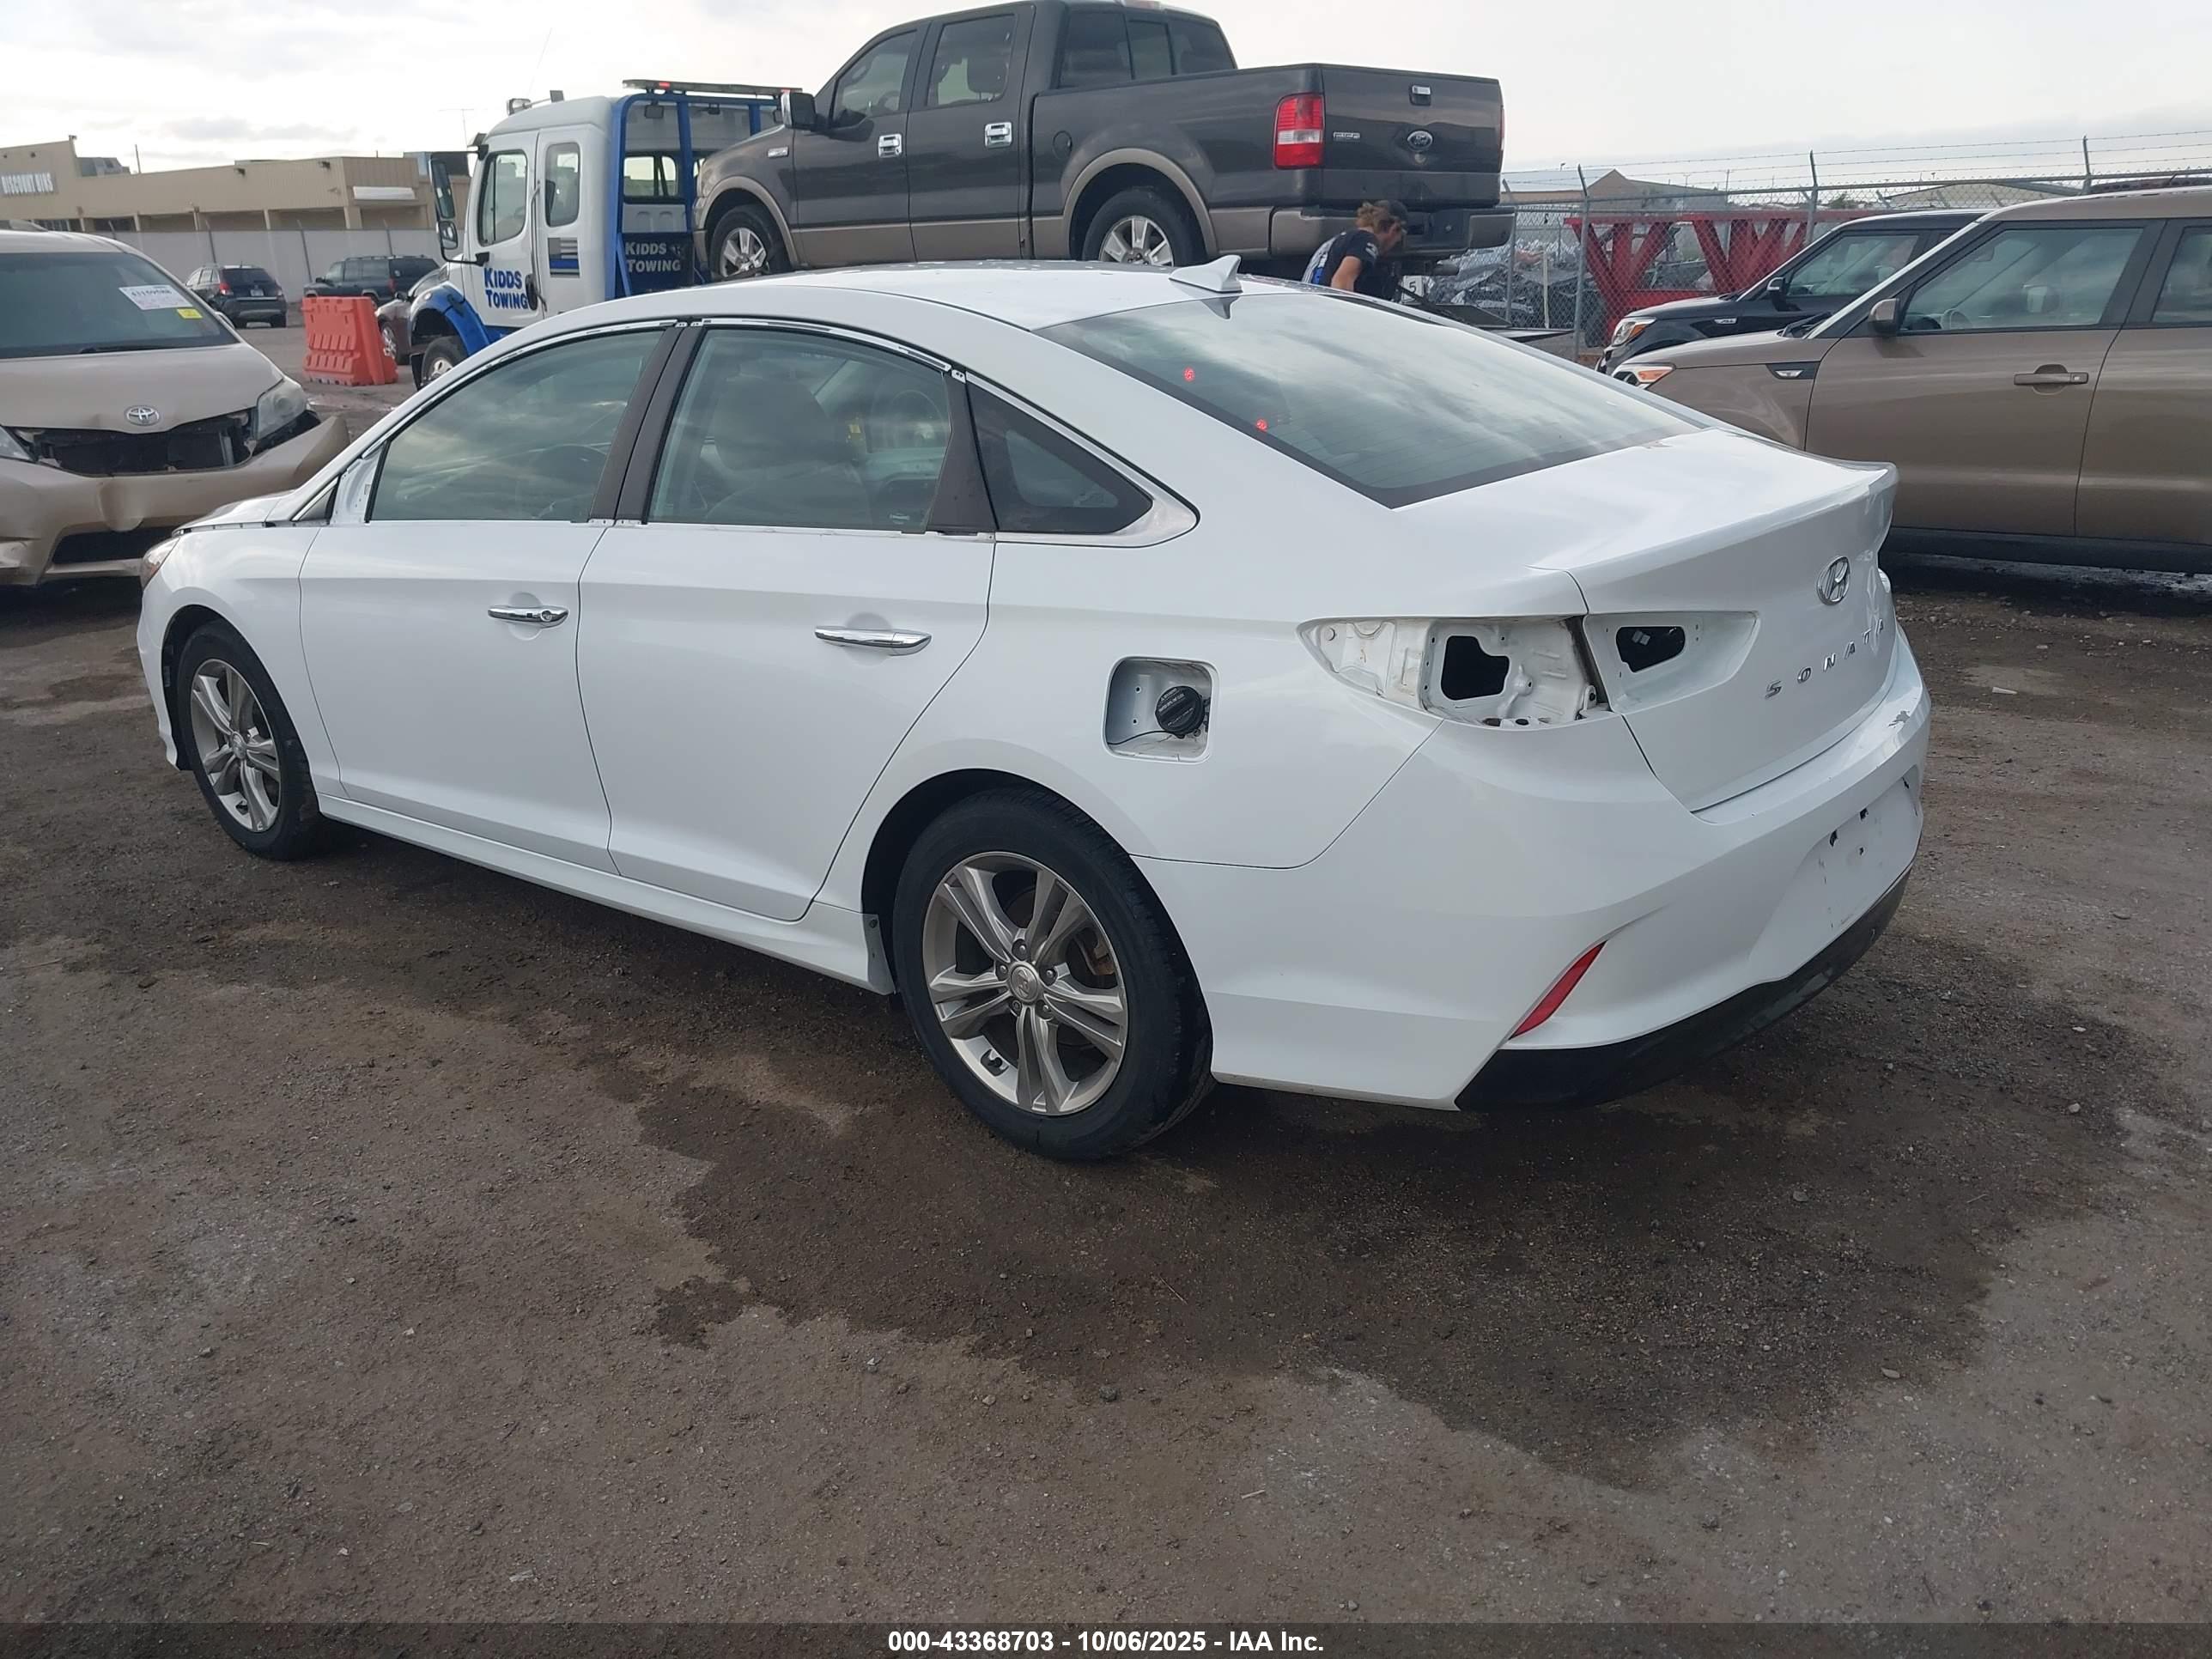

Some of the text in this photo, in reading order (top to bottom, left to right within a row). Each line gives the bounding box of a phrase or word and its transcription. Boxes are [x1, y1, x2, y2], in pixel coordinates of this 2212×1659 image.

[625, 242, 667, 255] KIDDS
[627, 259, 681, 272] TOWING
[483, 267, 523, 289] KIDDS
[485, 289, 529, 310] TOWING
[1765, 618, 1884, 700] SONATA
